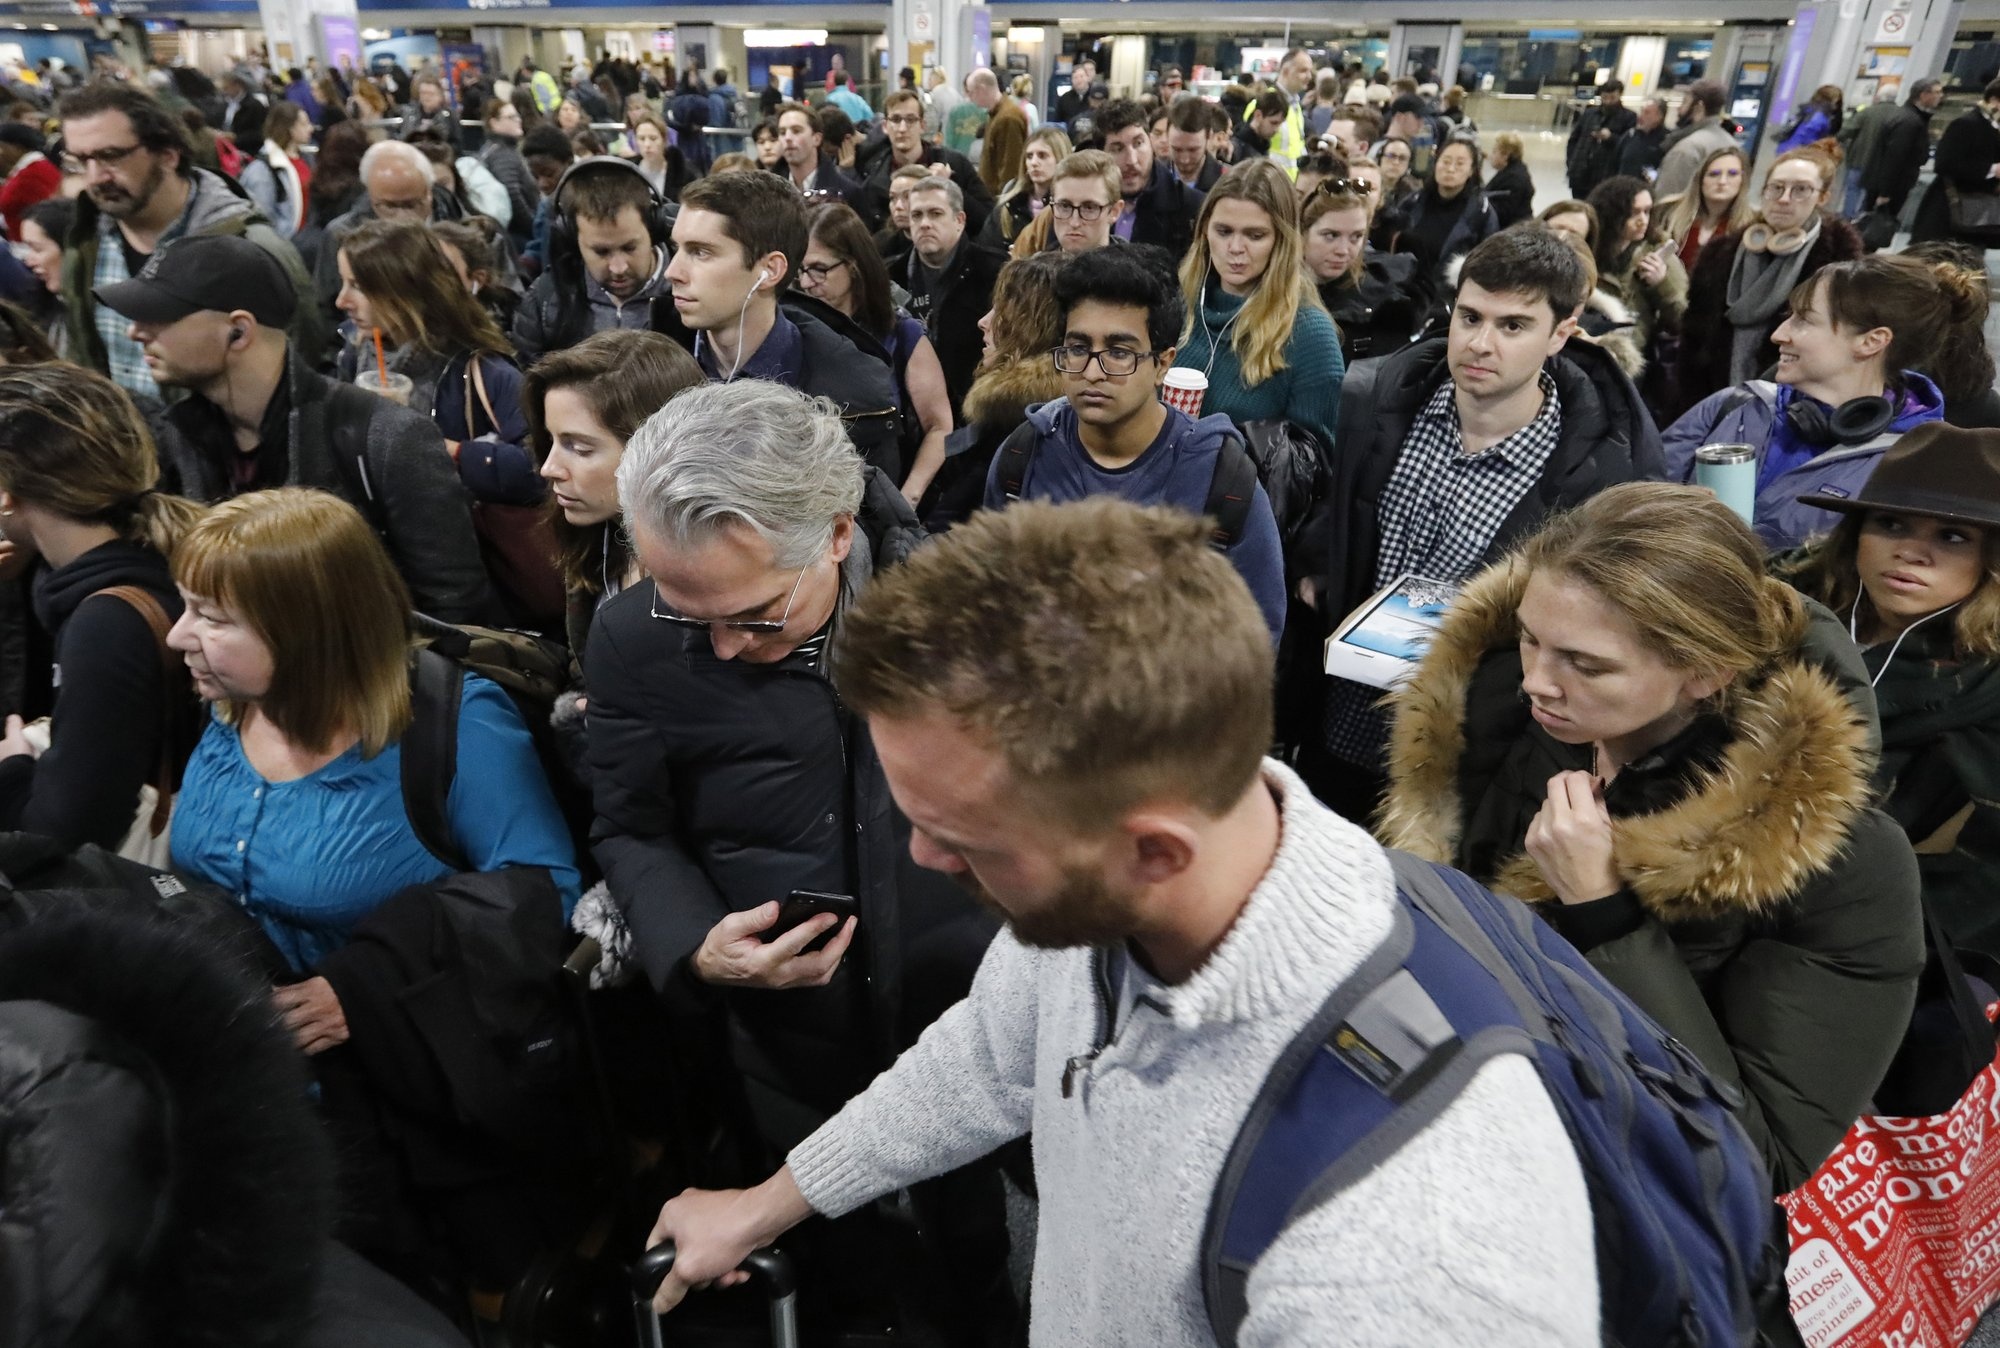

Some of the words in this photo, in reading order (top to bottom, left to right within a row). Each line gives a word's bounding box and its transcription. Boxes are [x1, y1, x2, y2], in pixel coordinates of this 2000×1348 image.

[1892, 1075, 1986, 1154] more
[1817, 1140, 1878, 1202] are
[1834, 1150, 1956, 1219] important
[1847, 1113, 1985, 1252] money
[1812, 1249, 1831, 1269] of
[1845, 1249, 1886, 1301] sufficient
